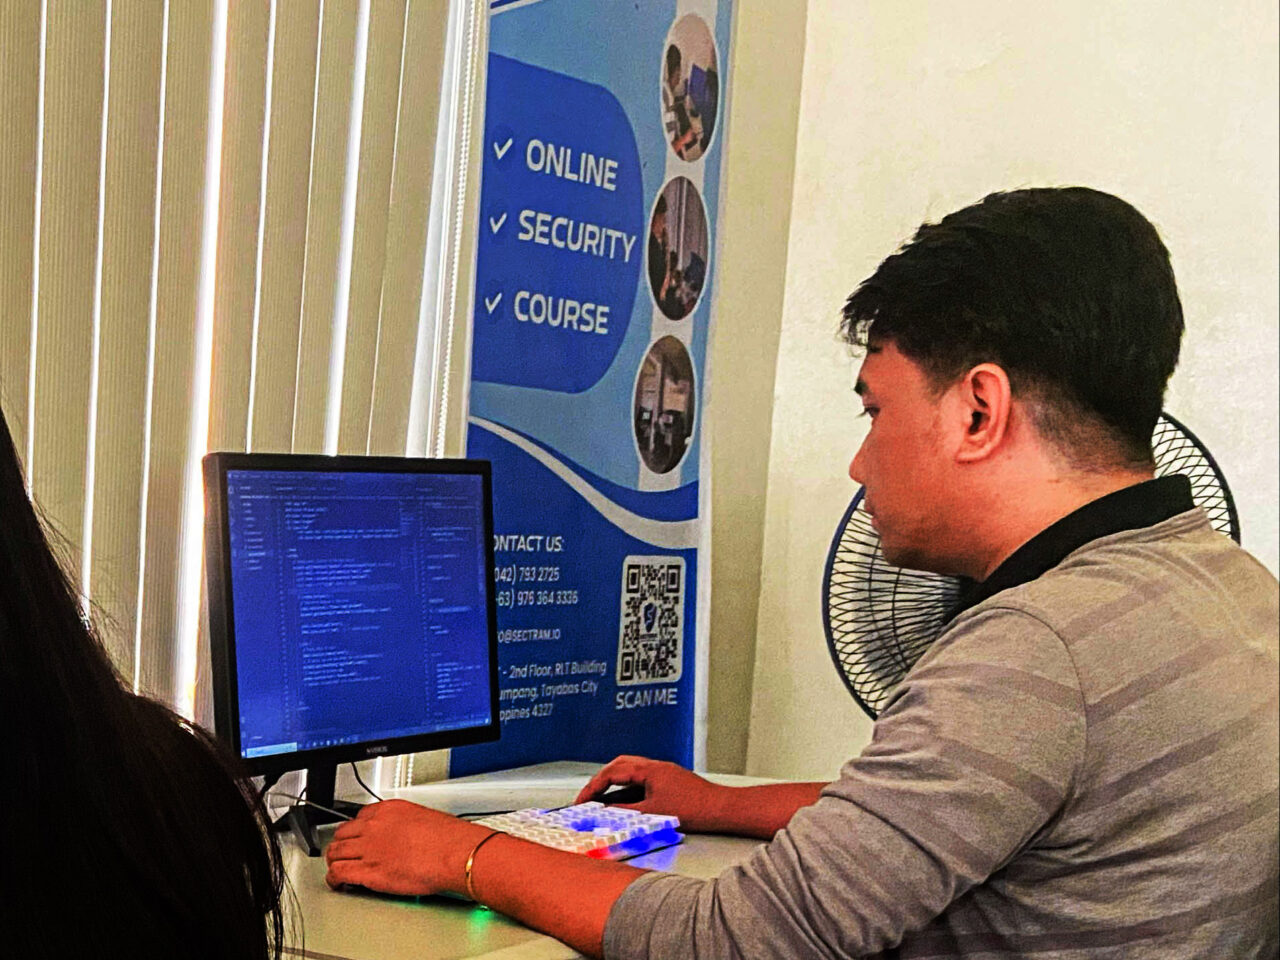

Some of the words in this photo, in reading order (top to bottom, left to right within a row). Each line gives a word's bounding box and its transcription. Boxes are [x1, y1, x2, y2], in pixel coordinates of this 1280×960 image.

[525, 139, 619, 191] ONLINE
[517, 209, 637, 263] SECURITY
[513, 290, 610, 334] COURSE
[494, 534, 544, 552] ONTACT
[494, 564, 517, 585] 042)
[537, 566, 560, 582] 2725
[509, 664, 528, 679] 2nd
[581, 681, 599, 696] City
[615, 691, 652, 710] SCAN
[654, 688, 678, 706] ME
